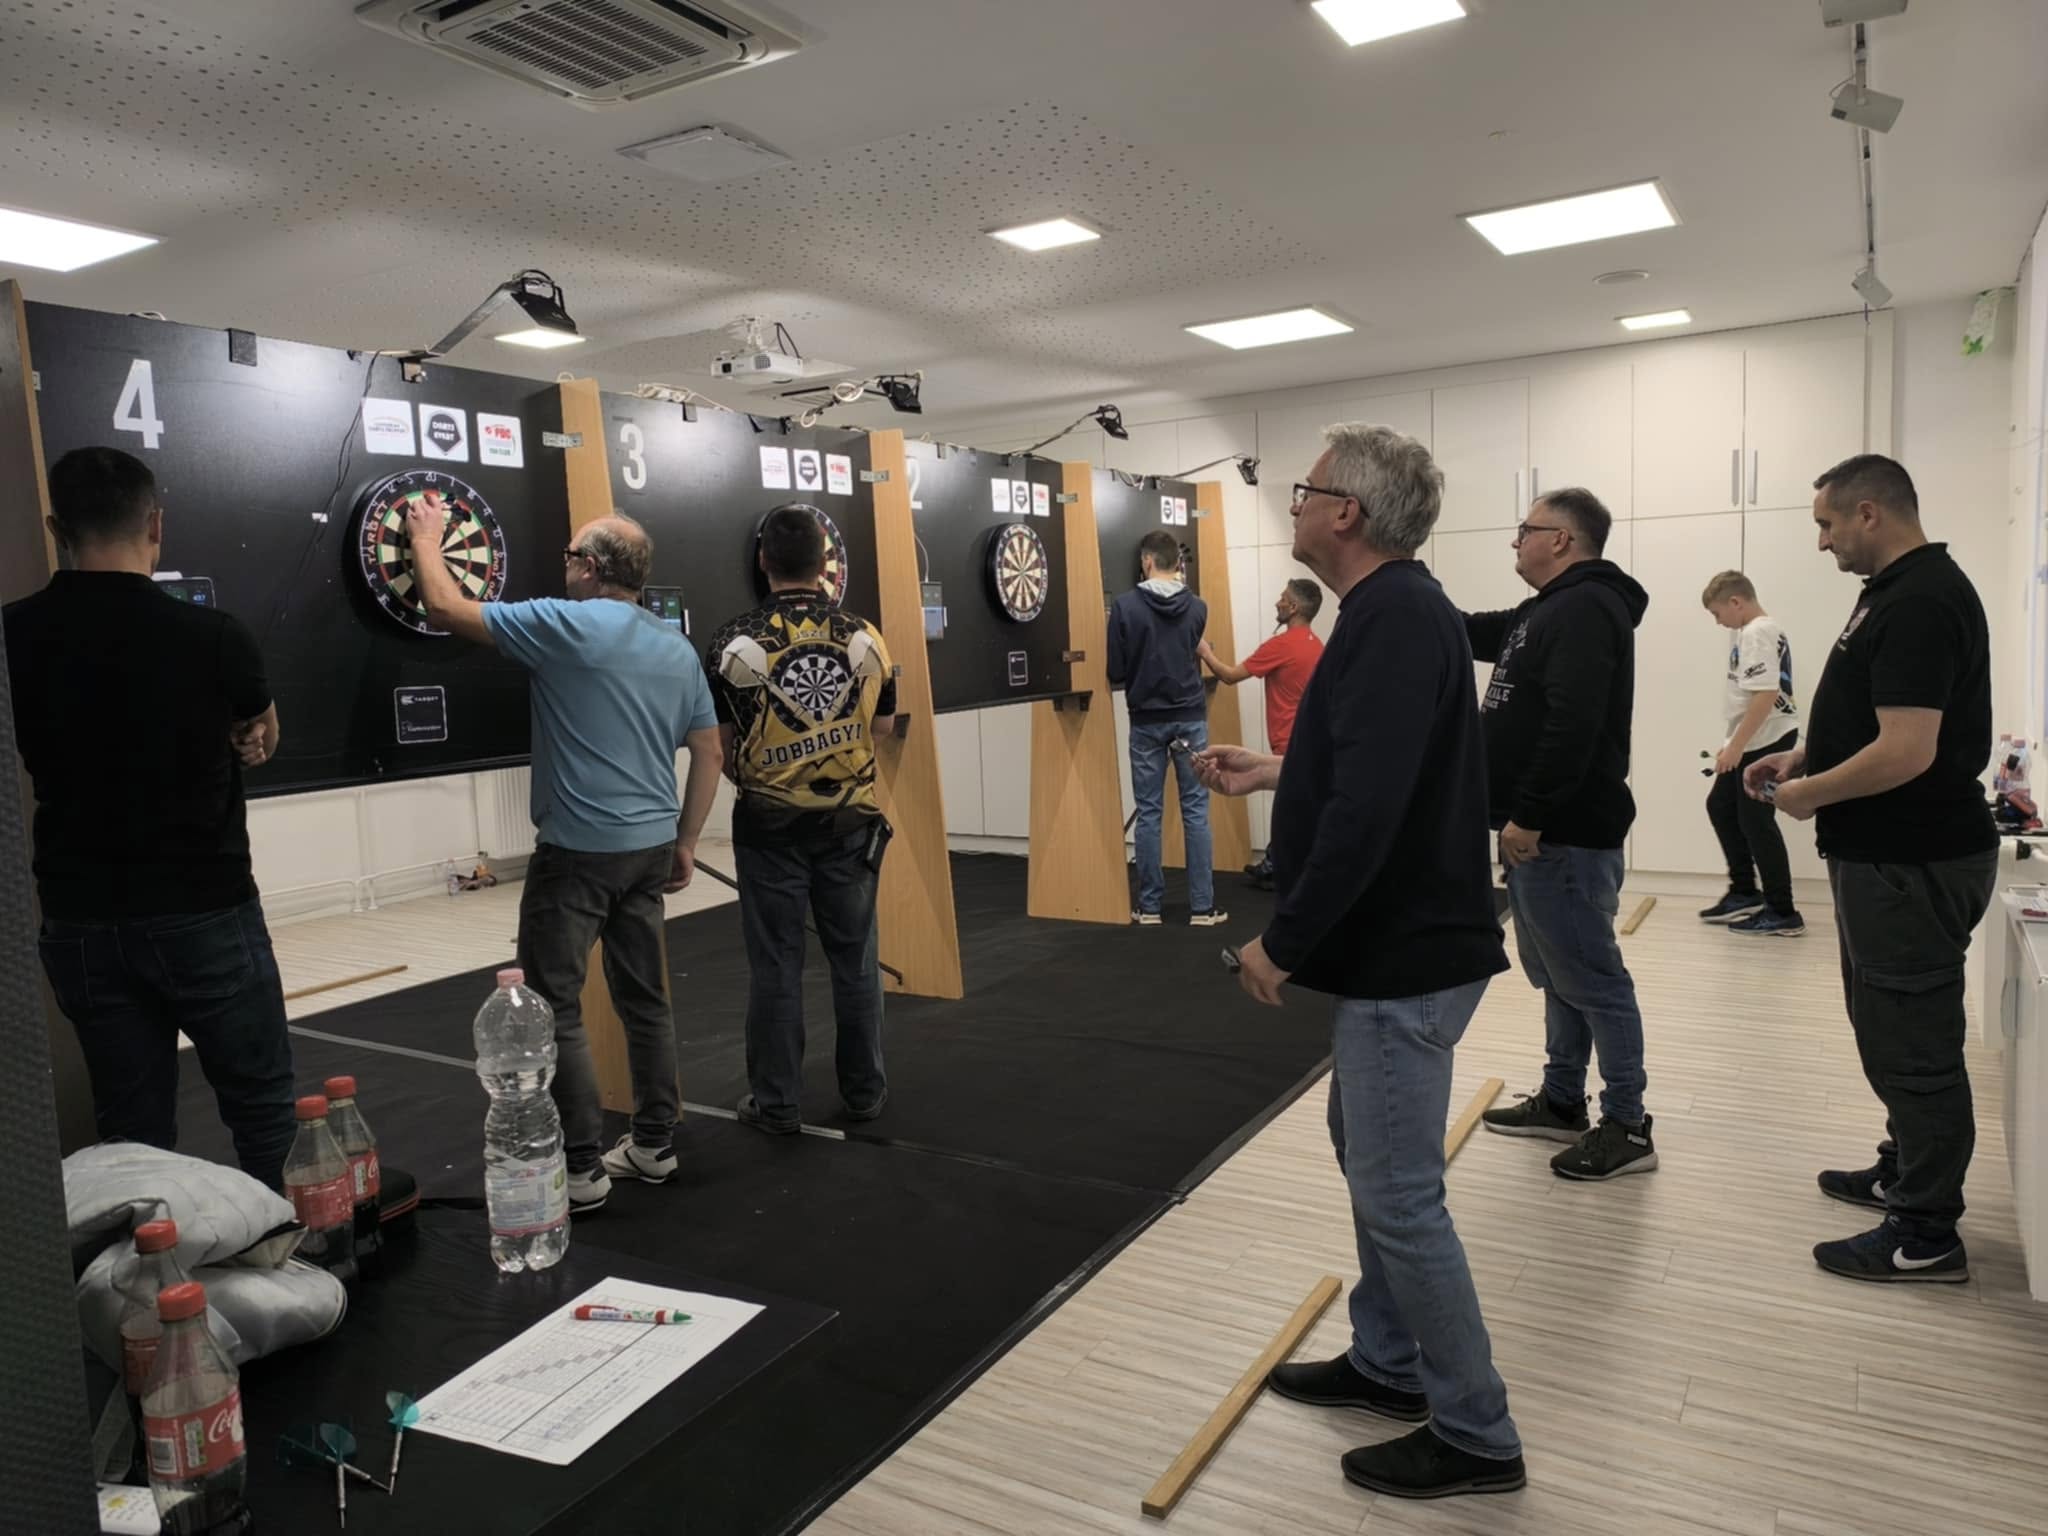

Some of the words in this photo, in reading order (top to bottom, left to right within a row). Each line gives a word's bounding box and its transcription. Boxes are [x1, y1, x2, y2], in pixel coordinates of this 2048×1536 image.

[113, 358, 165, 449] 4
[620, 423, 647, 490] 3
[906, 456, 923, 509] 2
[367, 500, 388, 565] TARGET
